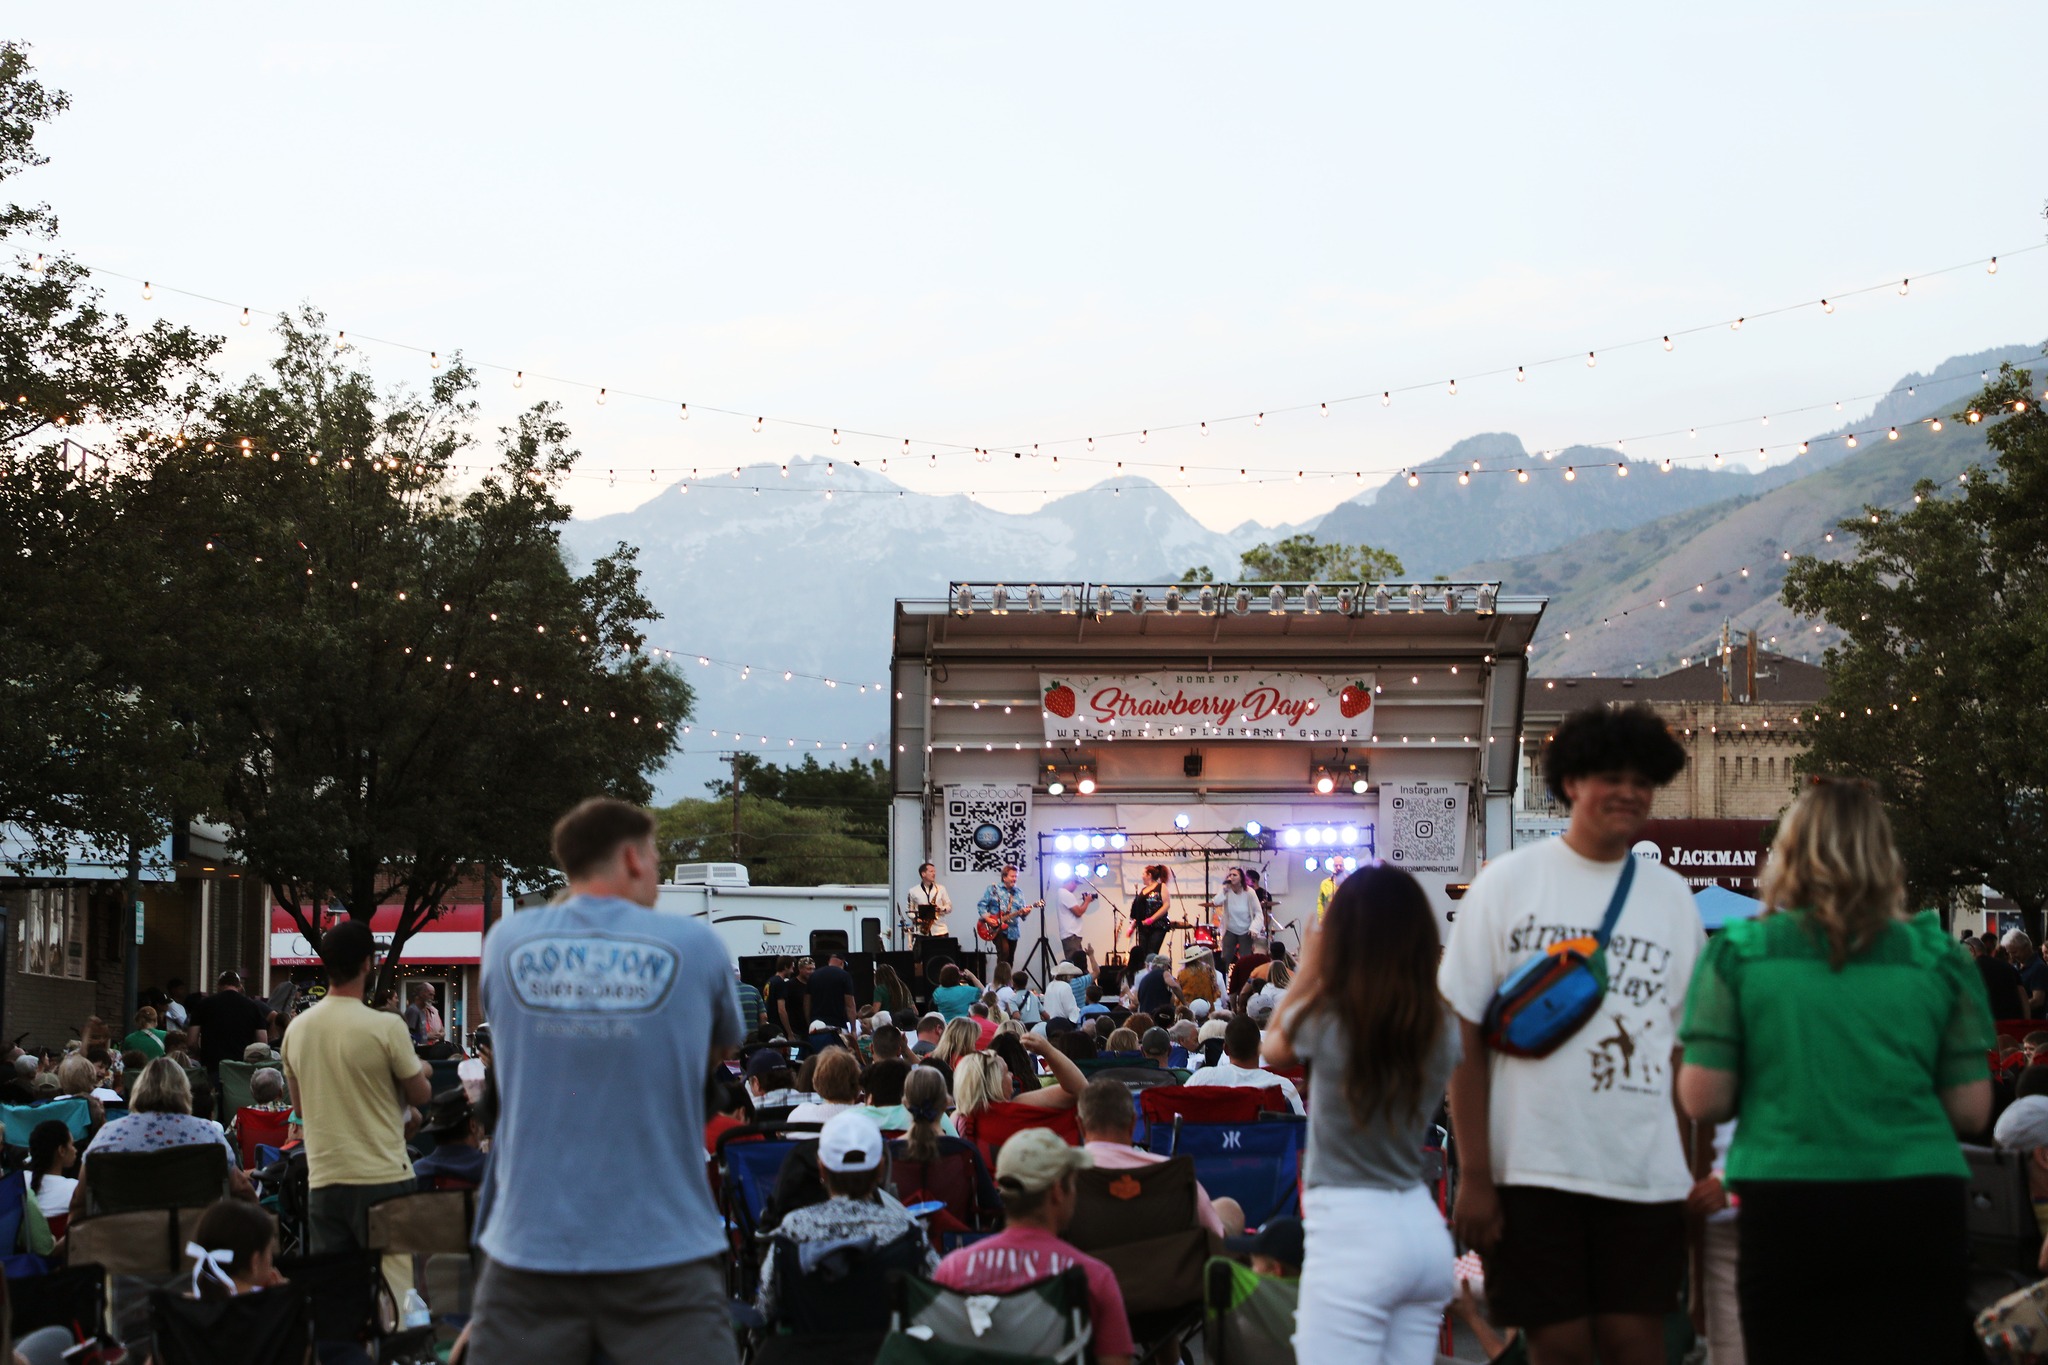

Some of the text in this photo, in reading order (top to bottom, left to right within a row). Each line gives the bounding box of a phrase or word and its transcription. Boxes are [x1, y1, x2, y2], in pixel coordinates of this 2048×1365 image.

[1176, 675, 1239, 684] HOME OF
[1090, 687, 1320, 727] Strawberry Days
[1056, 729, 1146, 738] WELCOME
[1190, 728, 1286, 738] PLEASANT
[951, 787, 1024, 799] Facebook
[1400, 785, 1448, 796] Instagram
[1190, 844, 1232, 858] Grve
[1669, 847, 1757, 866] JACKMAN
[1683, 877, 1718, 887] SERVICE
[1729, 878, 1741, 888] TV
[758, 941, 803, 955] SPRINTER
[276, 958, 308, 966] Boutique
